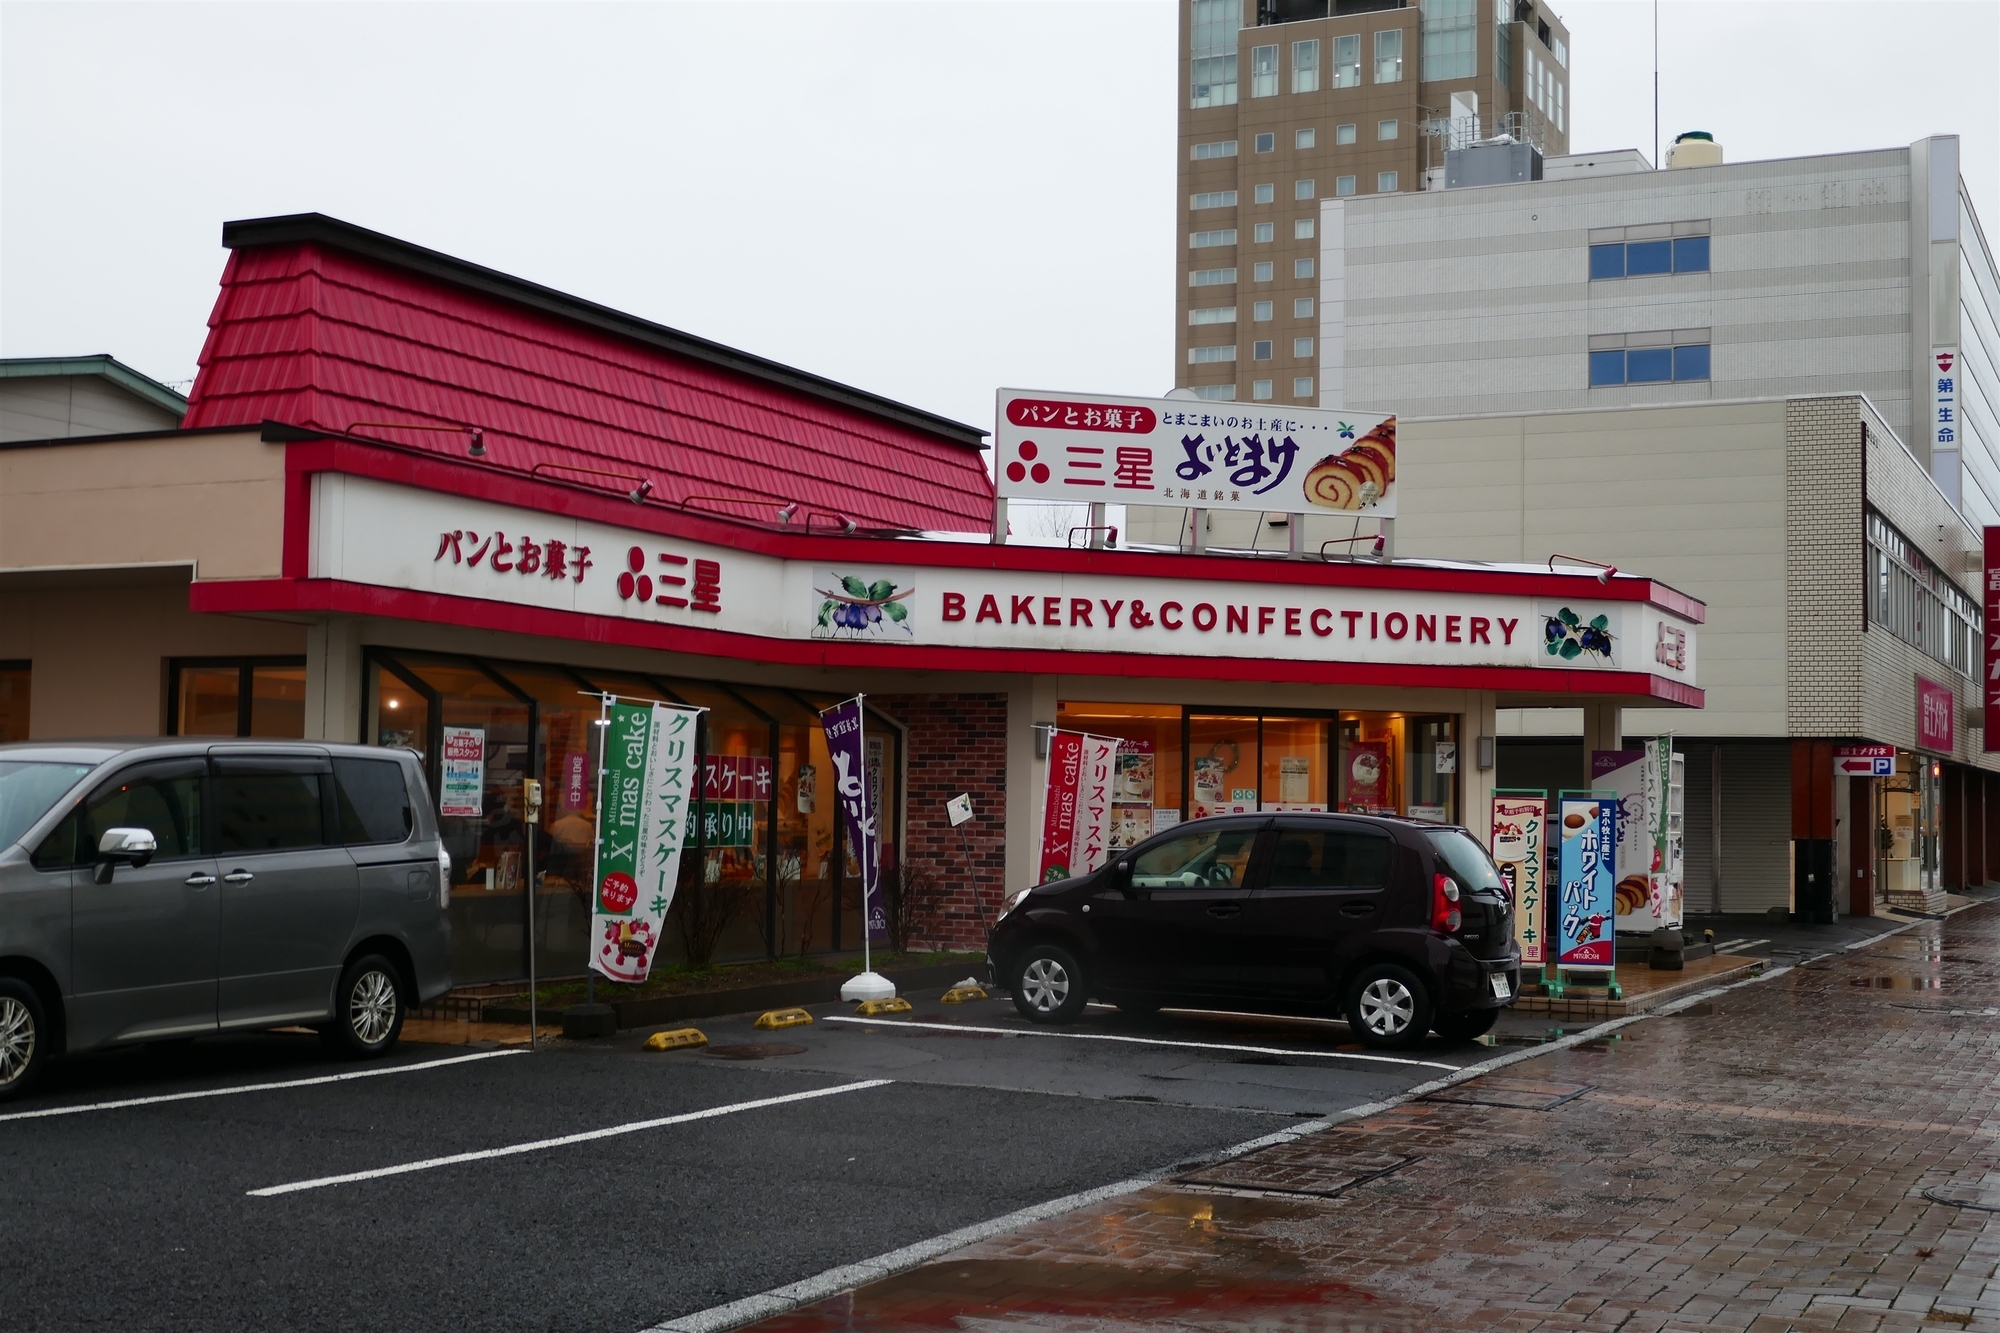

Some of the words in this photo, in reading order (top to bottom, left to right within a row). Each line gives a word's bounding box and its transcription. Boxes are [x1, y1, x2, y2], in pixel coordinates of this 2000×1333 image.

[1020, 404, 1144, 431] パンとお菓子
[1937, 377, 1954, 443] 第一生命
[1063, 445, 1156, 490] 三星
[1174, 432, 1300, 495] よいとまけ
[1163, 487, 1241, 502] 北海道銘菓
[433, 530, 594, 583] パンとお菓子
[655, 553, 722, 612] 三星
[622, 712, 648, 769] cake
[1923, 693, 1949, 741] 富士メガネ
[447, 748, 480, 758] 販売スタッフ
[452, 738, 475, 748] お菓子の
[1061, 742, 1080, 786] cake
[1840, 747, 1887, 756] 富士メガネ
[1875, 759, 1889, 774] P
[570, 755, 583, 807] 営業中
[607, 768, 621, 825] Mitsuboshi
[649, 713, 690, 919] クリスマスケーキ
[1050, 785, 1061, 827] Mitsuboshi
[1601, 808, 1611, 861] 苫小牧土産に
[604, 877, 629, 894] ご予約
[1522, 819, 1539, 943] クリスマスケーキ
[1581, 828, 1600, 910] ホワイト
[601, 886, 634, 906] 承ります
[1563, 881, 1582, 938] パック
[1572, 952, 1600, 961] MITSUBOSHI
